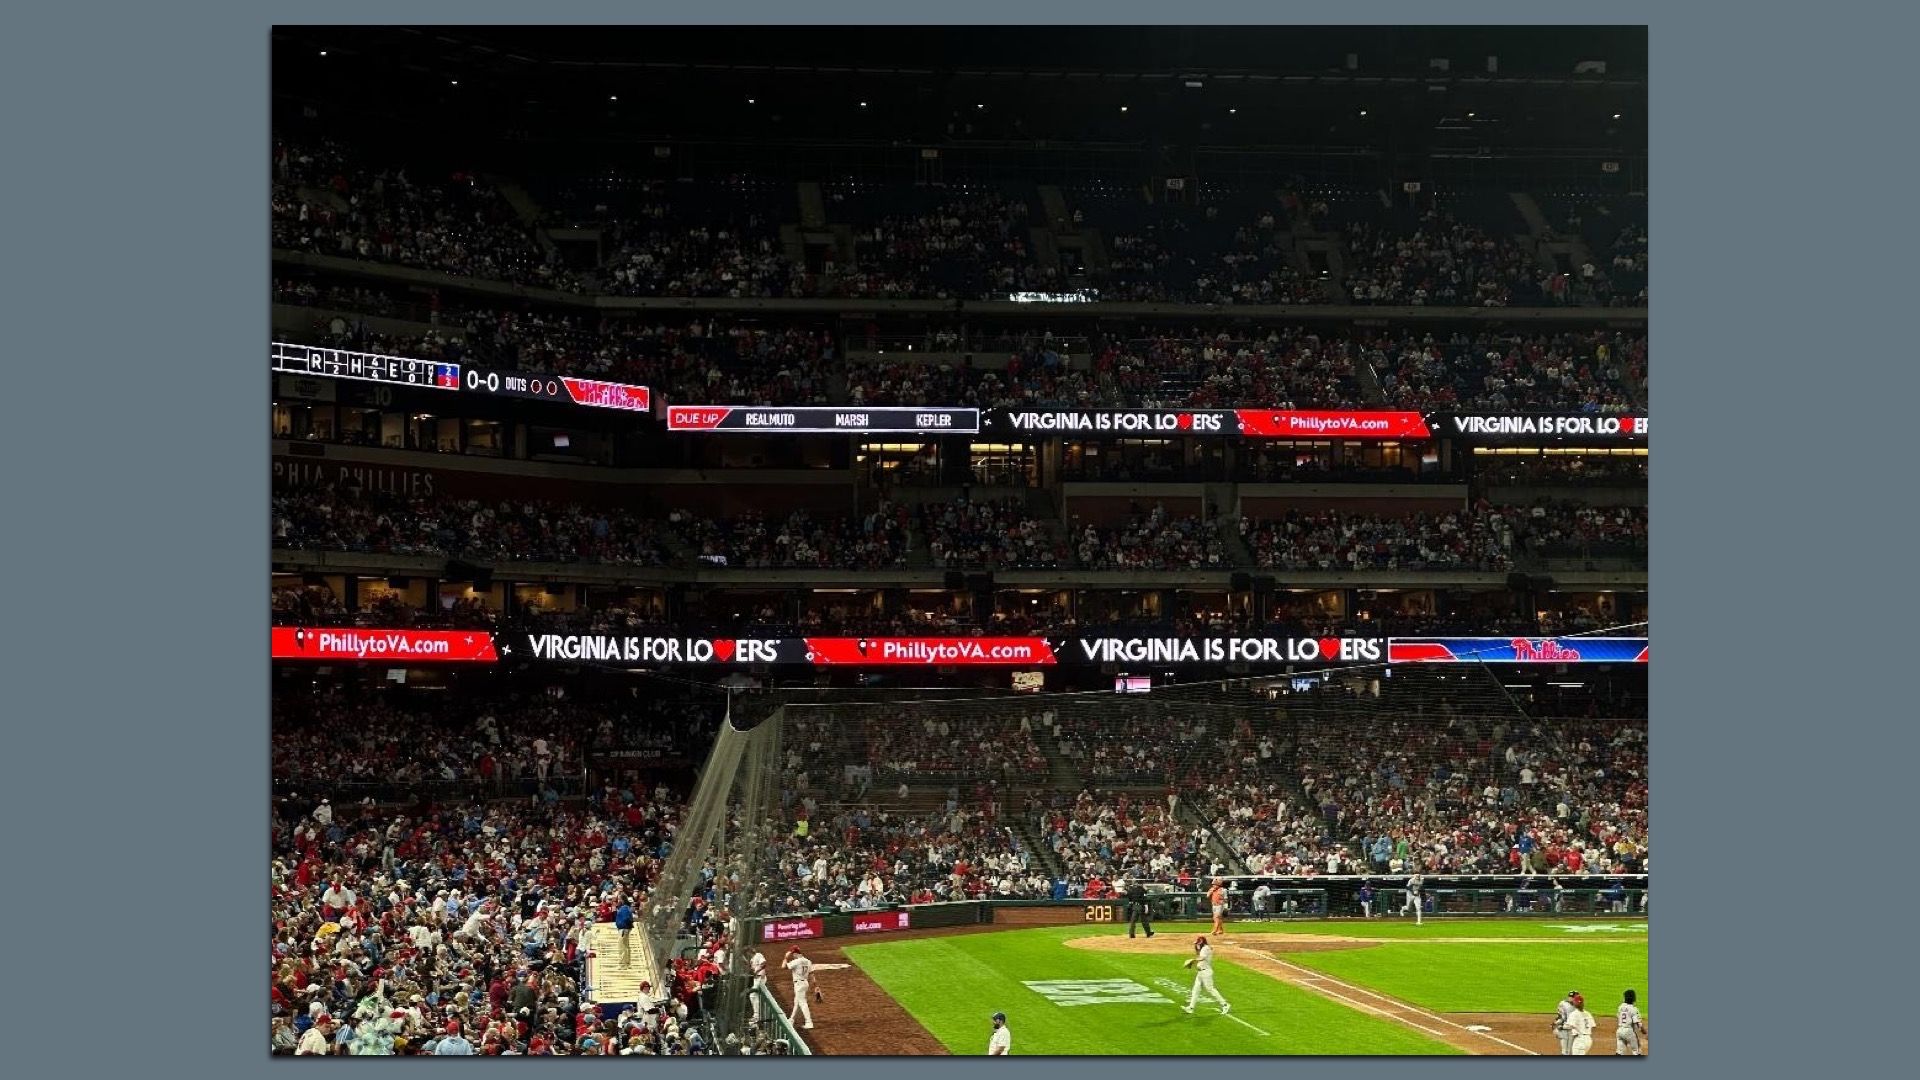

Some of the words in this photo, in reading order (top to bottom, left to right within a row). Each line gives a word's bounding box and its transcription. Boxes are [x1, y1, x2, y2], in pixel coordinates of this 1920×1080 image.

[311, 353, 322, 370] R
[333, 352, 339, 362] 1
[371, 357, 379, 367] 4
[333, 364, 339, 375] 2
[351, 358, 362, 374] H
[389, 362, 399, 378] E
[408, 361, 416, 371] 0
[445, 366, 452, 376] 2
[408, 373, 416, 383] 0
[445, 376, 452, 387] 3
[467, 370, 499, 392] 0-0
[505, 376, 527, 392] OUTS
[675, 412, 700, 425] DUE
[702, 412, 719, 425] UP
[745, 412, 795, 427] REALMUTO
[835, 412, 869, 427] MARSH
[915, 412, 952, 427] KEPLER
[1008, 412, 1093, 430] VIRGINIA
[1095, 412, 1112, 430] IS
[1114, 413, 1152, 430] FOR
[1290, 415, 1391, 433] PhillytoVA.com
[1454, 416, 1537, 434] VIRGINIA
[1538, 416, 1554, 434] IS
[1555, 416, 1595, 434] FOR
[319, 632, 449, 657] PhillytoVA.com
[528, 634, 622, 661] VIRGINIA
[623, 636, 640, 661] IS
[643, 636, 683, 662] FOR
[883, 641, 1031, 663] PhillytoVA.com
[1079, 637, 1201, 661] VIRGINIA
[1204, 637, 1226, 661] IS
[1229, 637, 1284, 661] FOR
[1510, 637, 1581, 661] Phillies
[1085, 905, 1112, 922] 203
